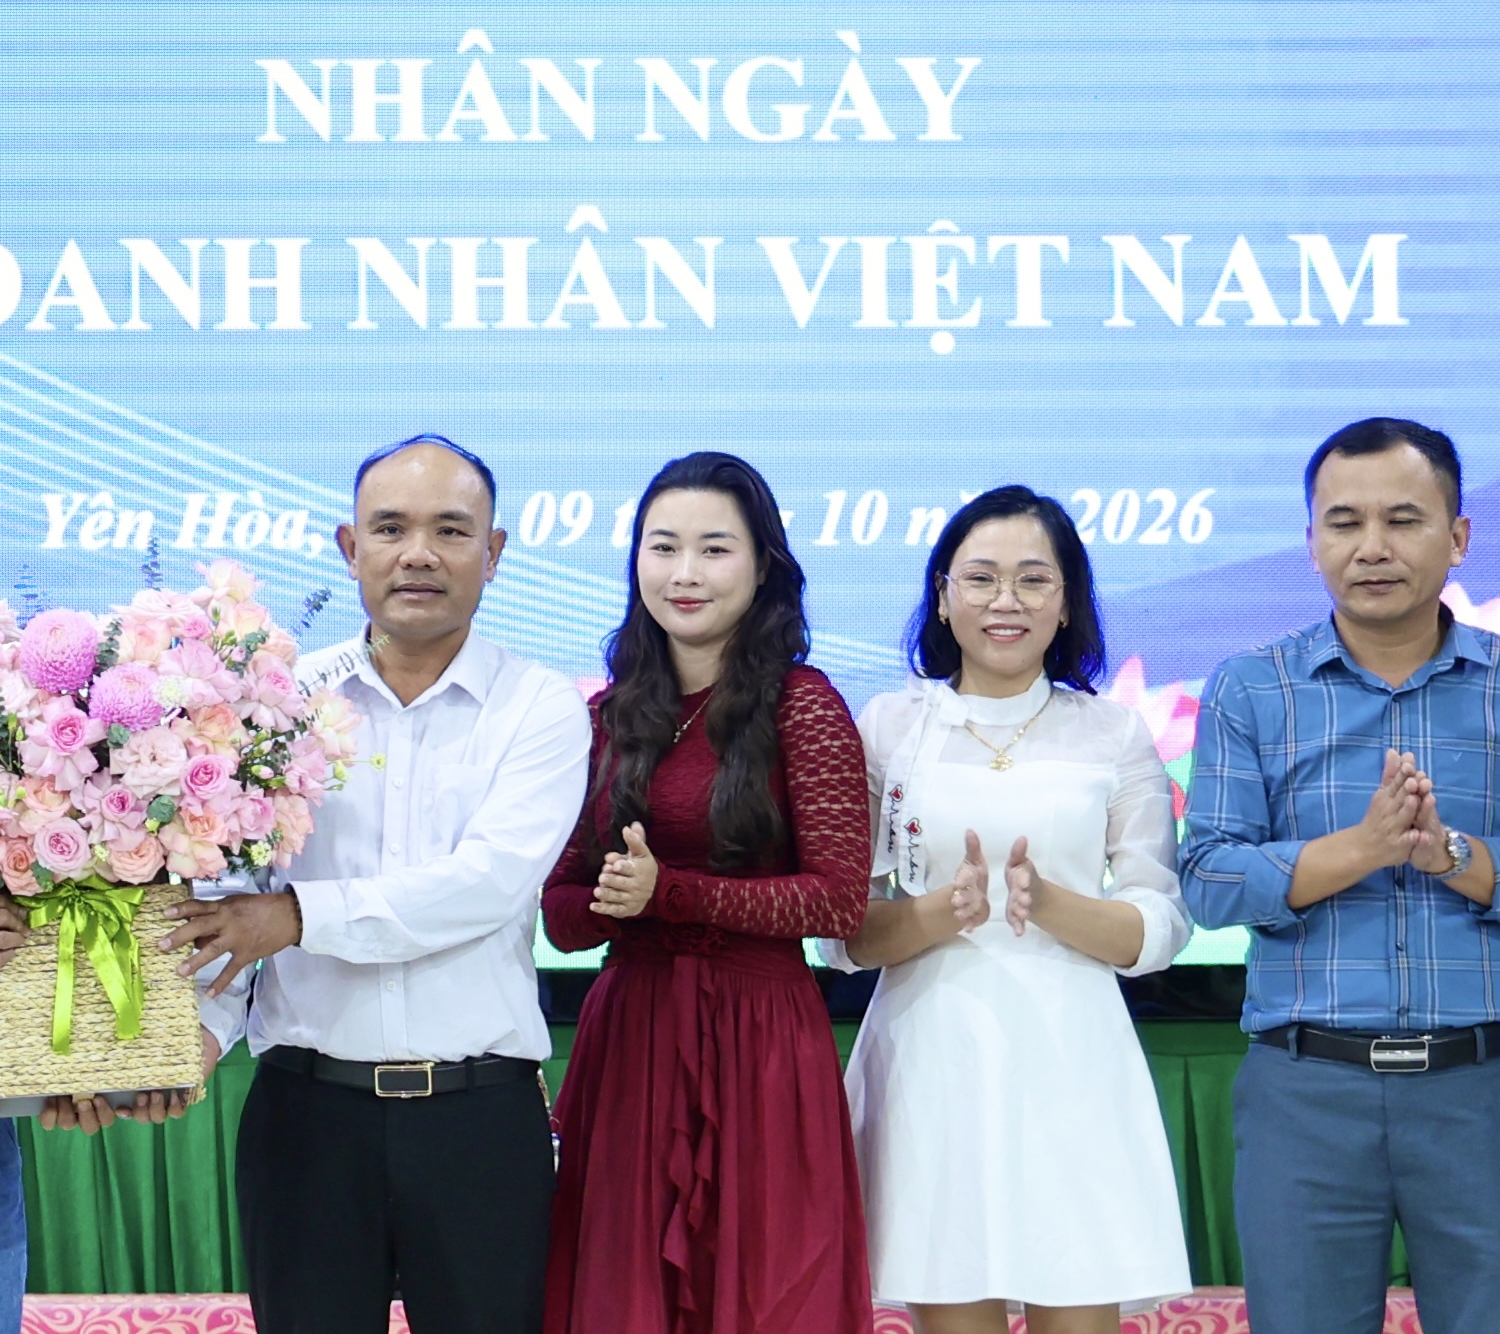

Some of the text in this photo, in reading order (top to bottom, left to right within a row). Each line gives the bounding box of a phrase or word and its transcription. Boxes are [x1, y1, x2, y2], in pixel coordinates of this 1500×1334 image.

[254, 28, 983, 144] NHÂN NGÀY
[346, 204, 725, 332] NHÂN
[755, 219, 1071, 356] VIỆT
[1101, 232, 1412, 328] NAM
[40, 491, 156, 550] Yên
[171, 490, 326, 559] Hòa,
[518, 489, 595, 548] 09
[812, 488, 890, 547] 10
[1069, 487, 1217, 546] 2026
